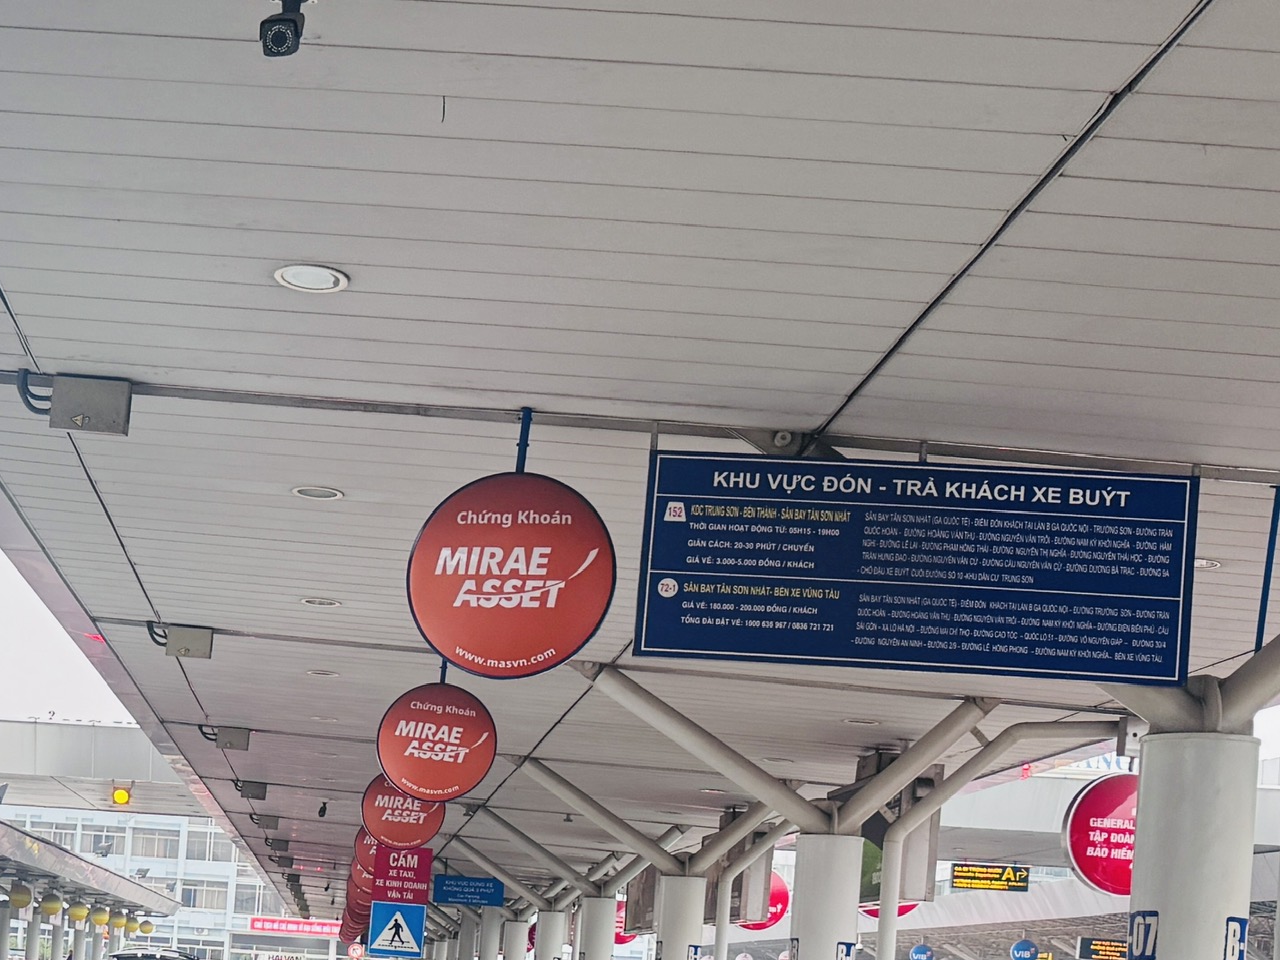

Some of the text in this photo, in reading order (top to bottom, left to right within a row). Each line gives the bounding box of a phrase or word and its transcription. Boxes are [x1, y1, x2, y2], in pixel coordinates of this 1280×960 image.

[712, 470, 1131, 507] KHU VỰC ĐÓN TRẢ KHÁCH XE BUÝT
[456, 510, 572, 529] Chứng Khoán
[666, 504, 684, 518] 152
[435, 547, 551, 575] MIRAE
[453, 579, 566, 608] ASSET
[658, 581, 676, 593] 72-1
[455, 645, 556, 669] www.masvn.com
[410, 701, 476, 718] Chứng Khoán
[395, 720, 463, 745] MIRAE
[404, 741, 469, 764] ASSET
[401, 777, 460, 795] www.masvn.com
[375, 794, 422, 811] MIRAE
[381, 811, 427, 824] ASSET
[1089, 830, 1108, 846] TẬP
[389, 850, 418, 868] CẤM
[1086, 843, 1109, 858] BẢO
[388, 869, 416, 879] XE TAXI,
[1002, 867, 1015, 880] A
[386, 880, 402, 888] KINH
[1014, 949, 1031, 959] VIB
